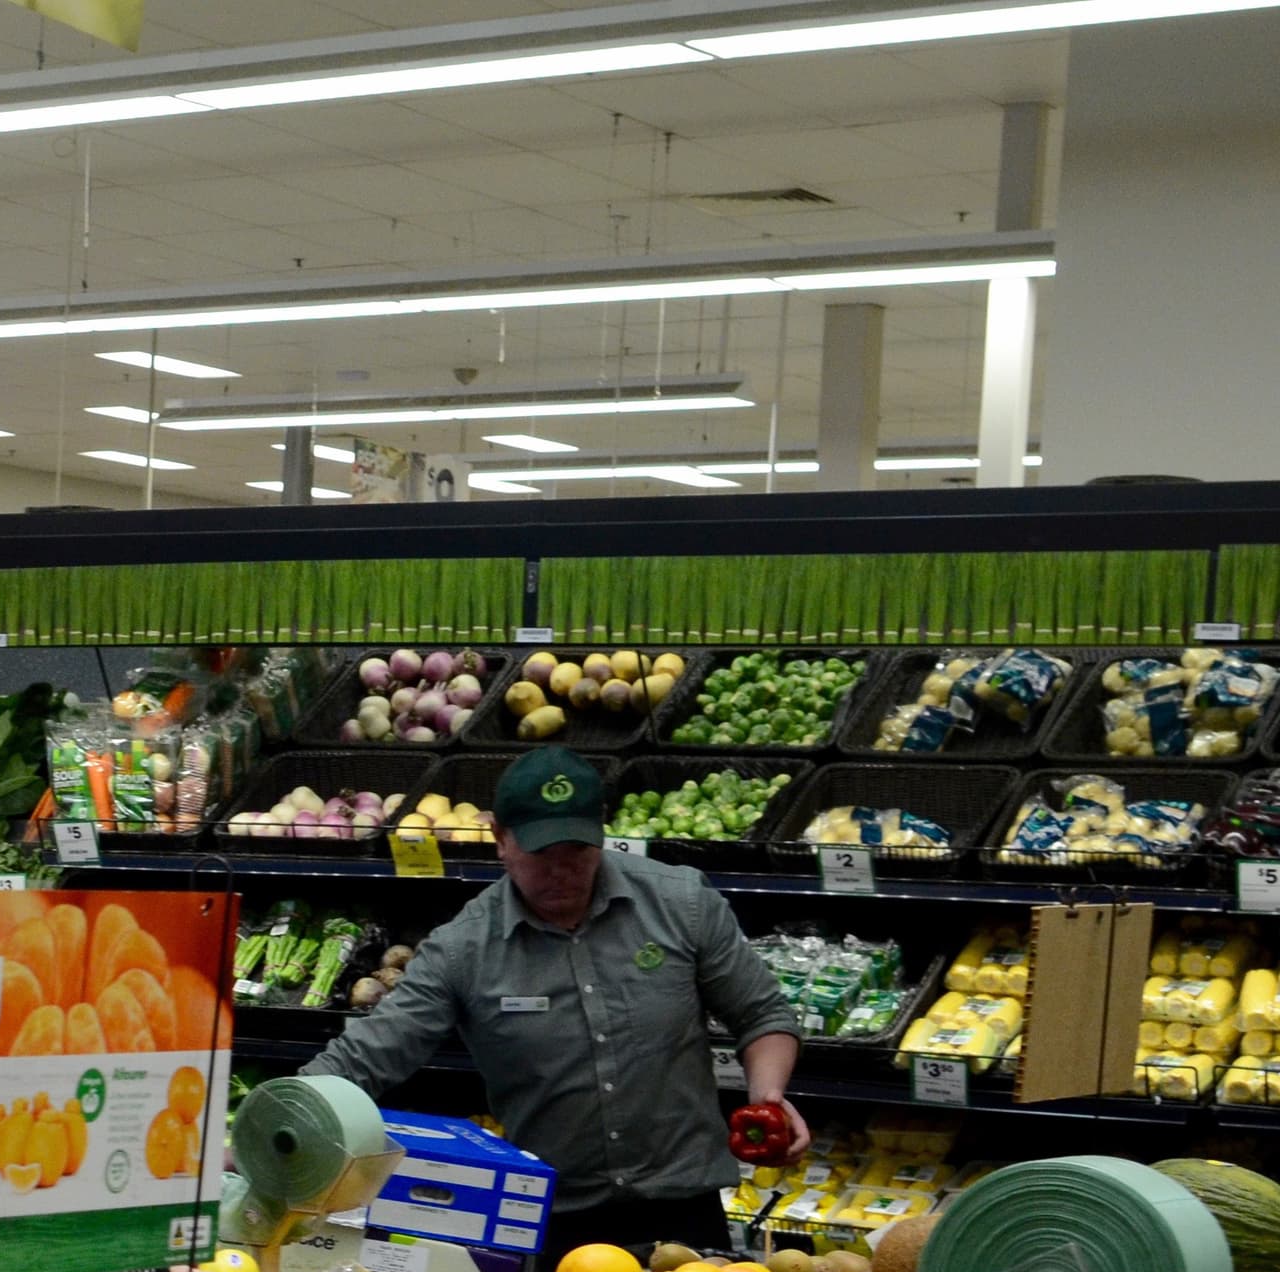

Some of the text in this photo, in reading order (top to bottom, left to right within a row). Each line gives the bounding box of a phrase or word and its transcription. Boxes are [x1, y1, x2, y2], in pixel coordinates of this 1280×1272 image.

[67, 826, 82, 839] $5
[836, 853, 854, 867] $2
[1258, 867, 1278, 884] $5
